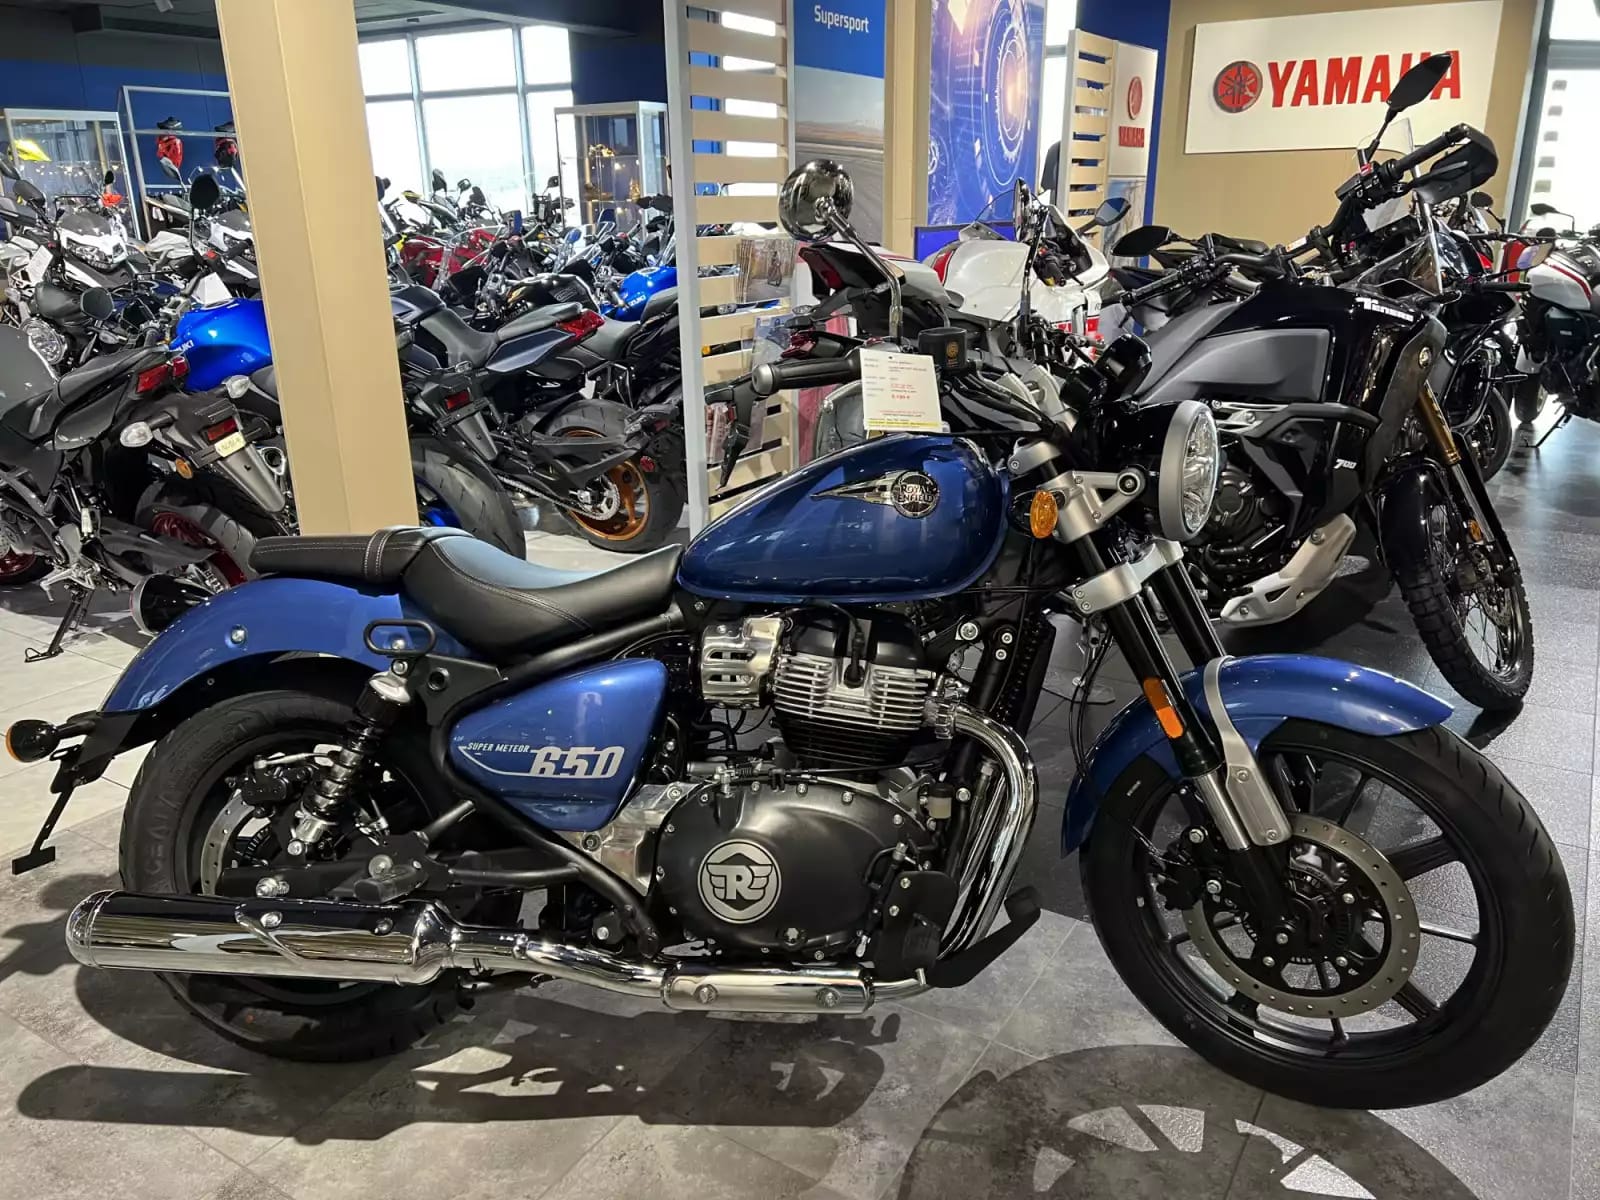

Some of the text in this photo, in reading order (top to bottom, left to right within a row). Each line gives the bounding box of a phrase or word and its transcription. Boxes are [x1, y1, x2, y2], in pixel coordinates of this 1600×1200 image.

[814, 4, 870, 35] Supersport
[1333, 458, 1357, 469] 700
[899, 483, 935, 494] ROYAL
[896, 493, 935, 503] ENFIELD
[467, 742, 625, 778] SUPER METEOR 650
